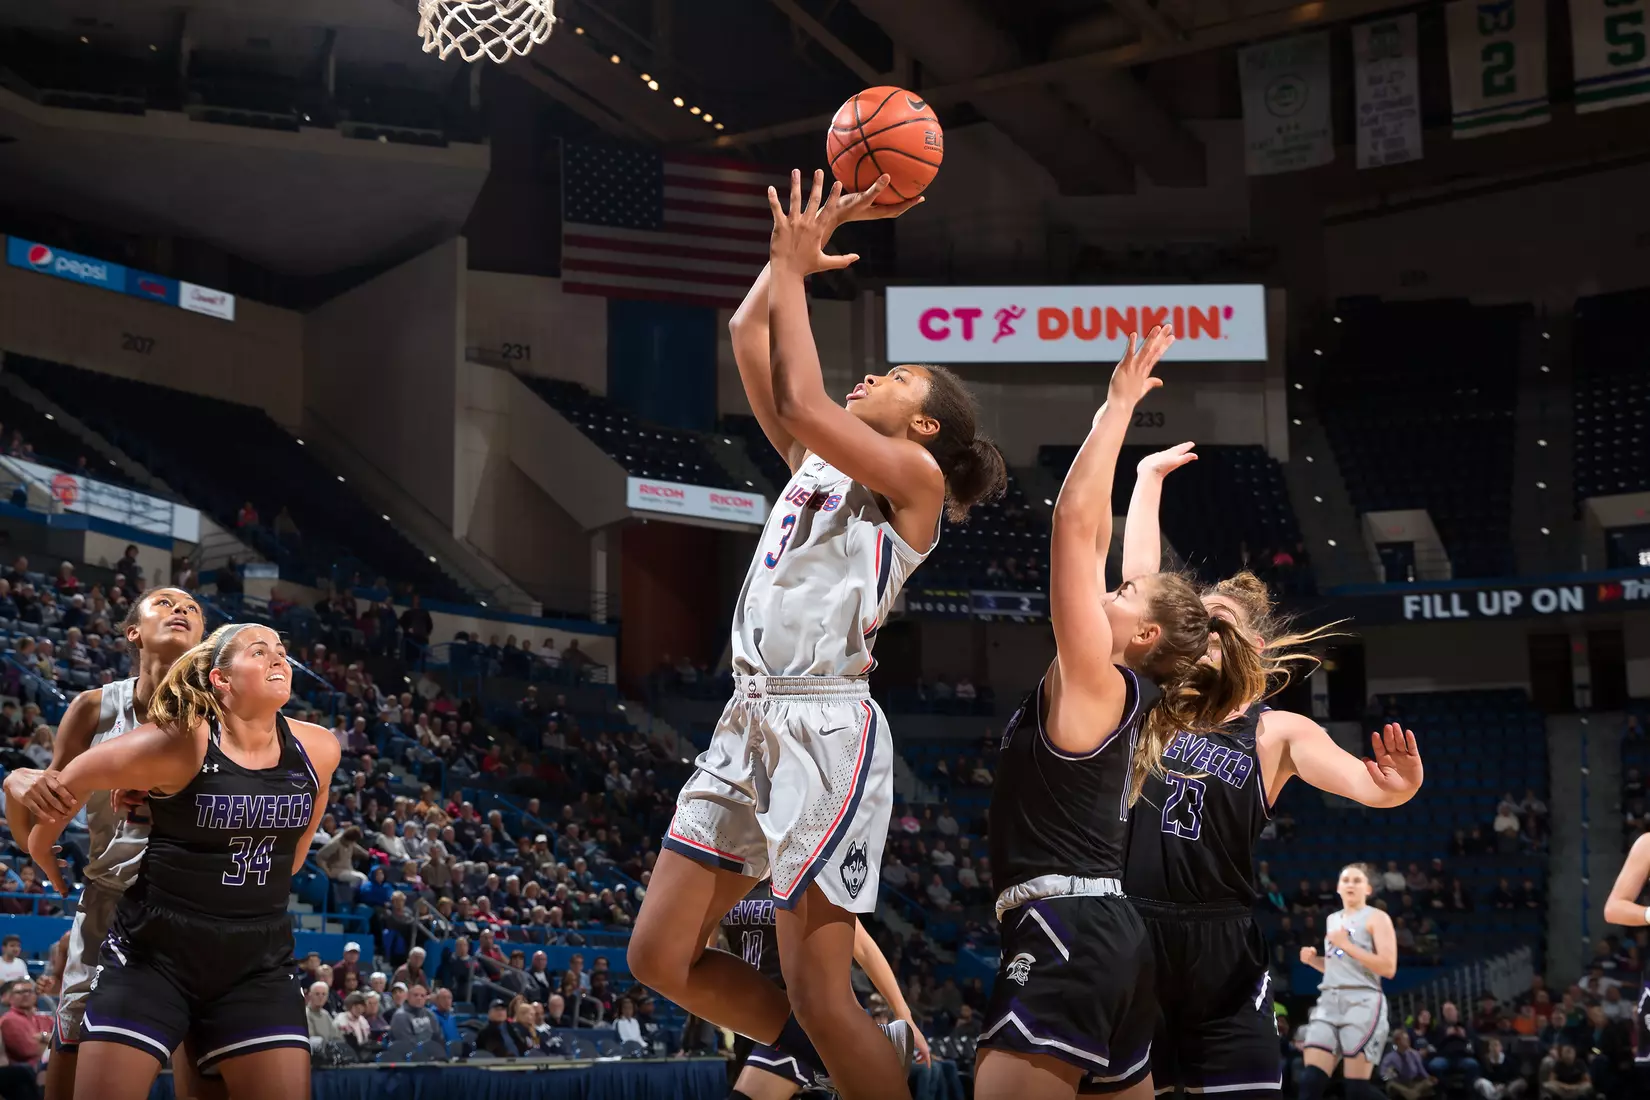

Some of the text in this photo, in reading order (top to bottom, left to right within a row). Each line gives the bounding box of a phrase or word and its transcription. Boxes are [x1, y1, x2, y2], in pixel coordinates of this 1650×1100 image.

[1604, 10, 1646, 66] 5
[1481, 40, 1517, 98] 2
[55, 256, 107, 281] pepsi
[918, 306, 1234, 341] CT DUNKIN'
[122, 333, 155, 355] 207
[502, 342, 530, 361] 231
[1134, 411, 1165, 428] 233
[764, 513, 797, 569] 3
[1402, 592, 1470, 620] FILL
[1476, 589, 1523, 617] UP
[1530, 585, 1585, 614] ON
[195, 792, 312, 829] TREVECCA
[1160, 769, 1207, 841] 23
[221, 835, 278, 886] 34
[742, 929, 764, 971] 10
